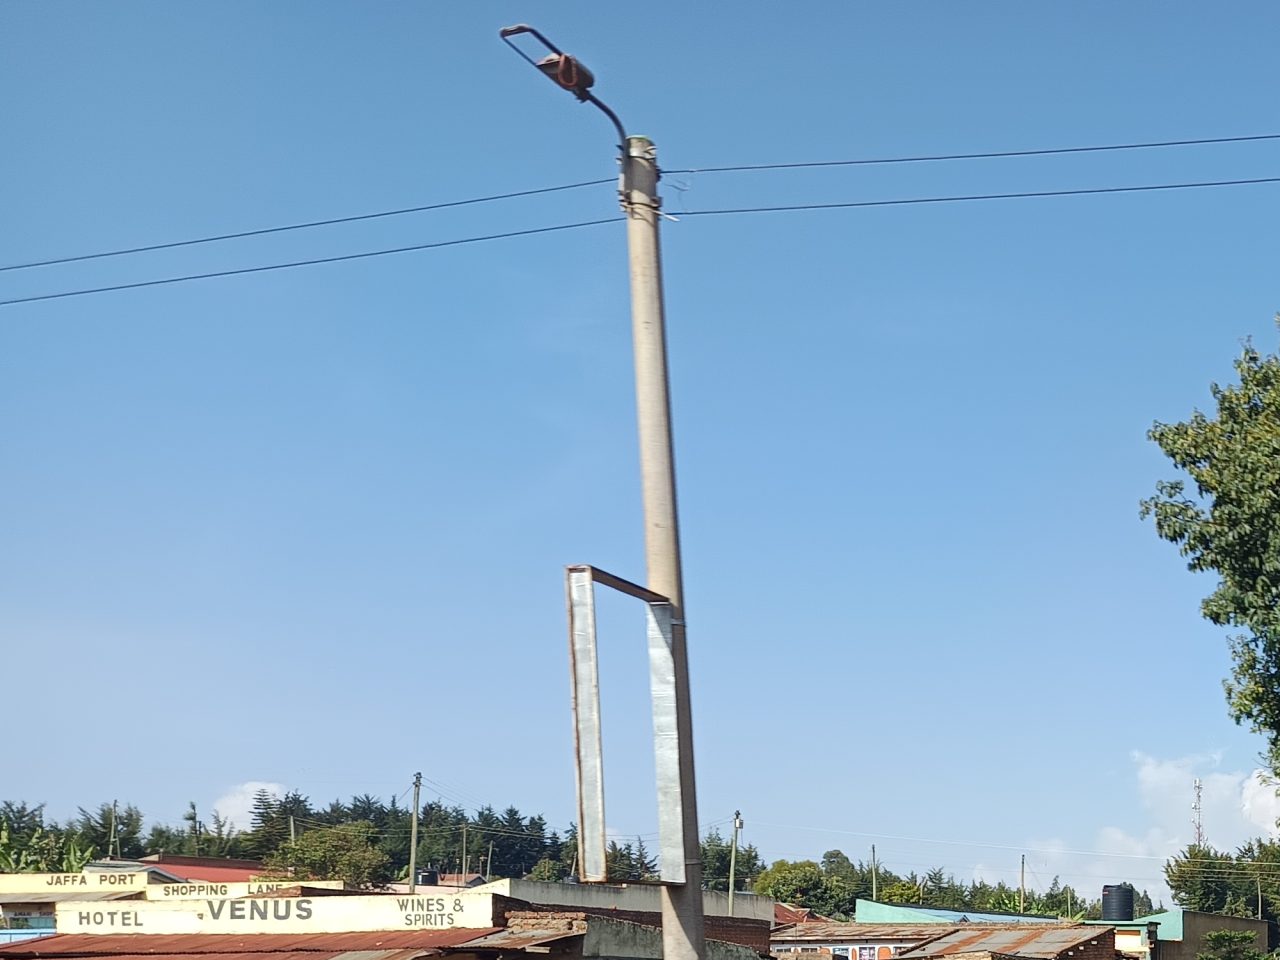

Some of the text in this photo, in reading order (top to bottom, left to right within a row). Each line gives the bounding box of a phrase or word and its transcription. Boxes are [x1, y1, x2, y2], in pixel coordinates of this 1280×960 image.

[46, 874, 136, 885] JAFFA PORT
[163, 885, 228, 896] SHOPPING
[207, 899, 313, 920] VENUS
[397, 898, 464, 912] WINES &
[79, 911, 143, 926] HOTEL
[405, 913, 454, 926] SPIRITS
